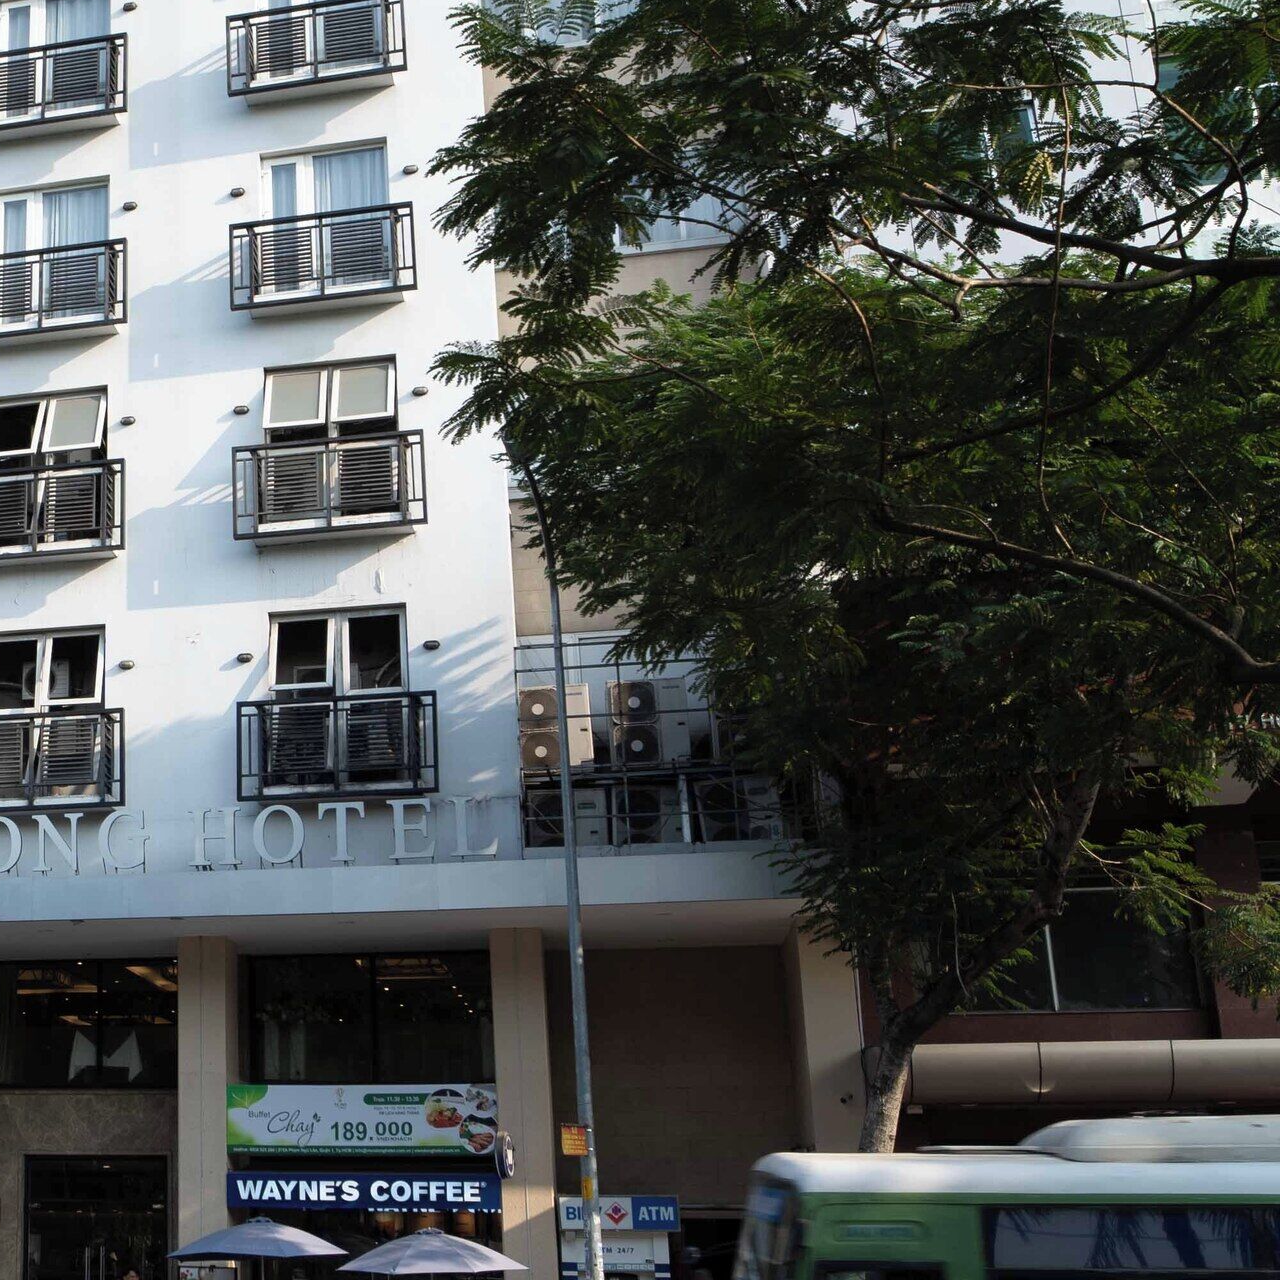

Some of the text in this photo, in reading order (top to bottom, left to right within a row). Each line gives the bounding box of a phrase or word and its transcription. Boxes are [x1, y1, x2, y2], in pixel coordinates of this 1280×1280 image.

[188, 796, 499, 868] HOTEL
[248, 1109, 315, 1146] Buffet Chay
[235, 1179, 482, 1203] WAYNE'S COFFEE
[638, 1206, 674, 1221] ATM
